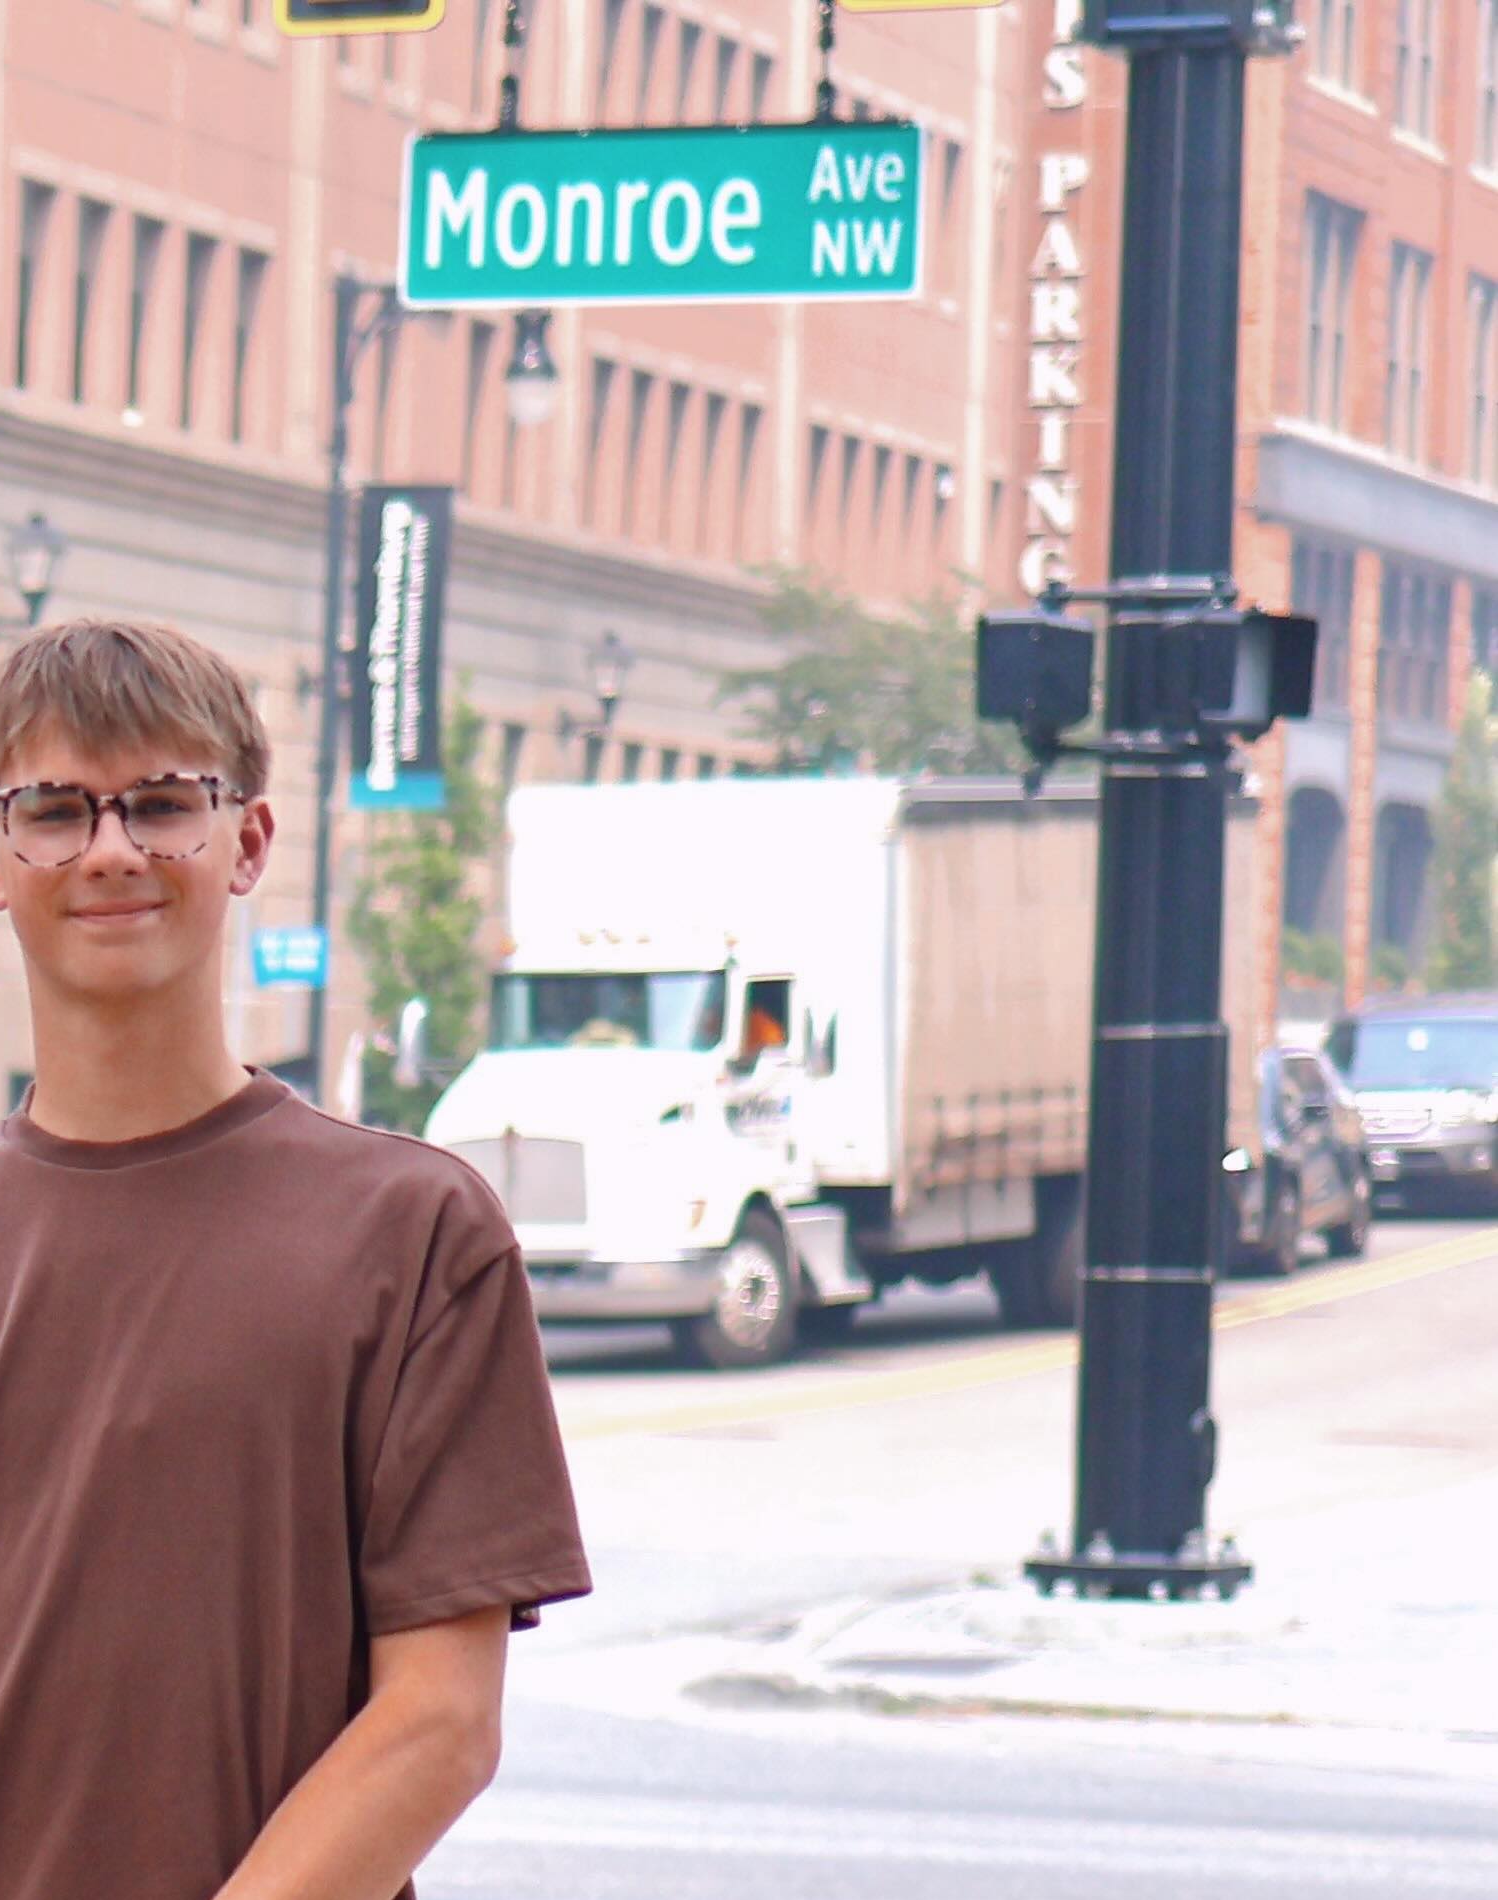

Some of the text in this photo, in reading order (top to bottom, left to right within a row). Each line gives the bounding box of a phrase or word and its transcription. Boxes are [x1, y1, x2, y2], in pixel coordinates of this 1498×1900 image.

[808, 145, 906, 204] Ave
[423, 166, 762, 270] Monroe
[811, 217, 903, 277] NW
[1018, 153, 1089, 603] PARKING
